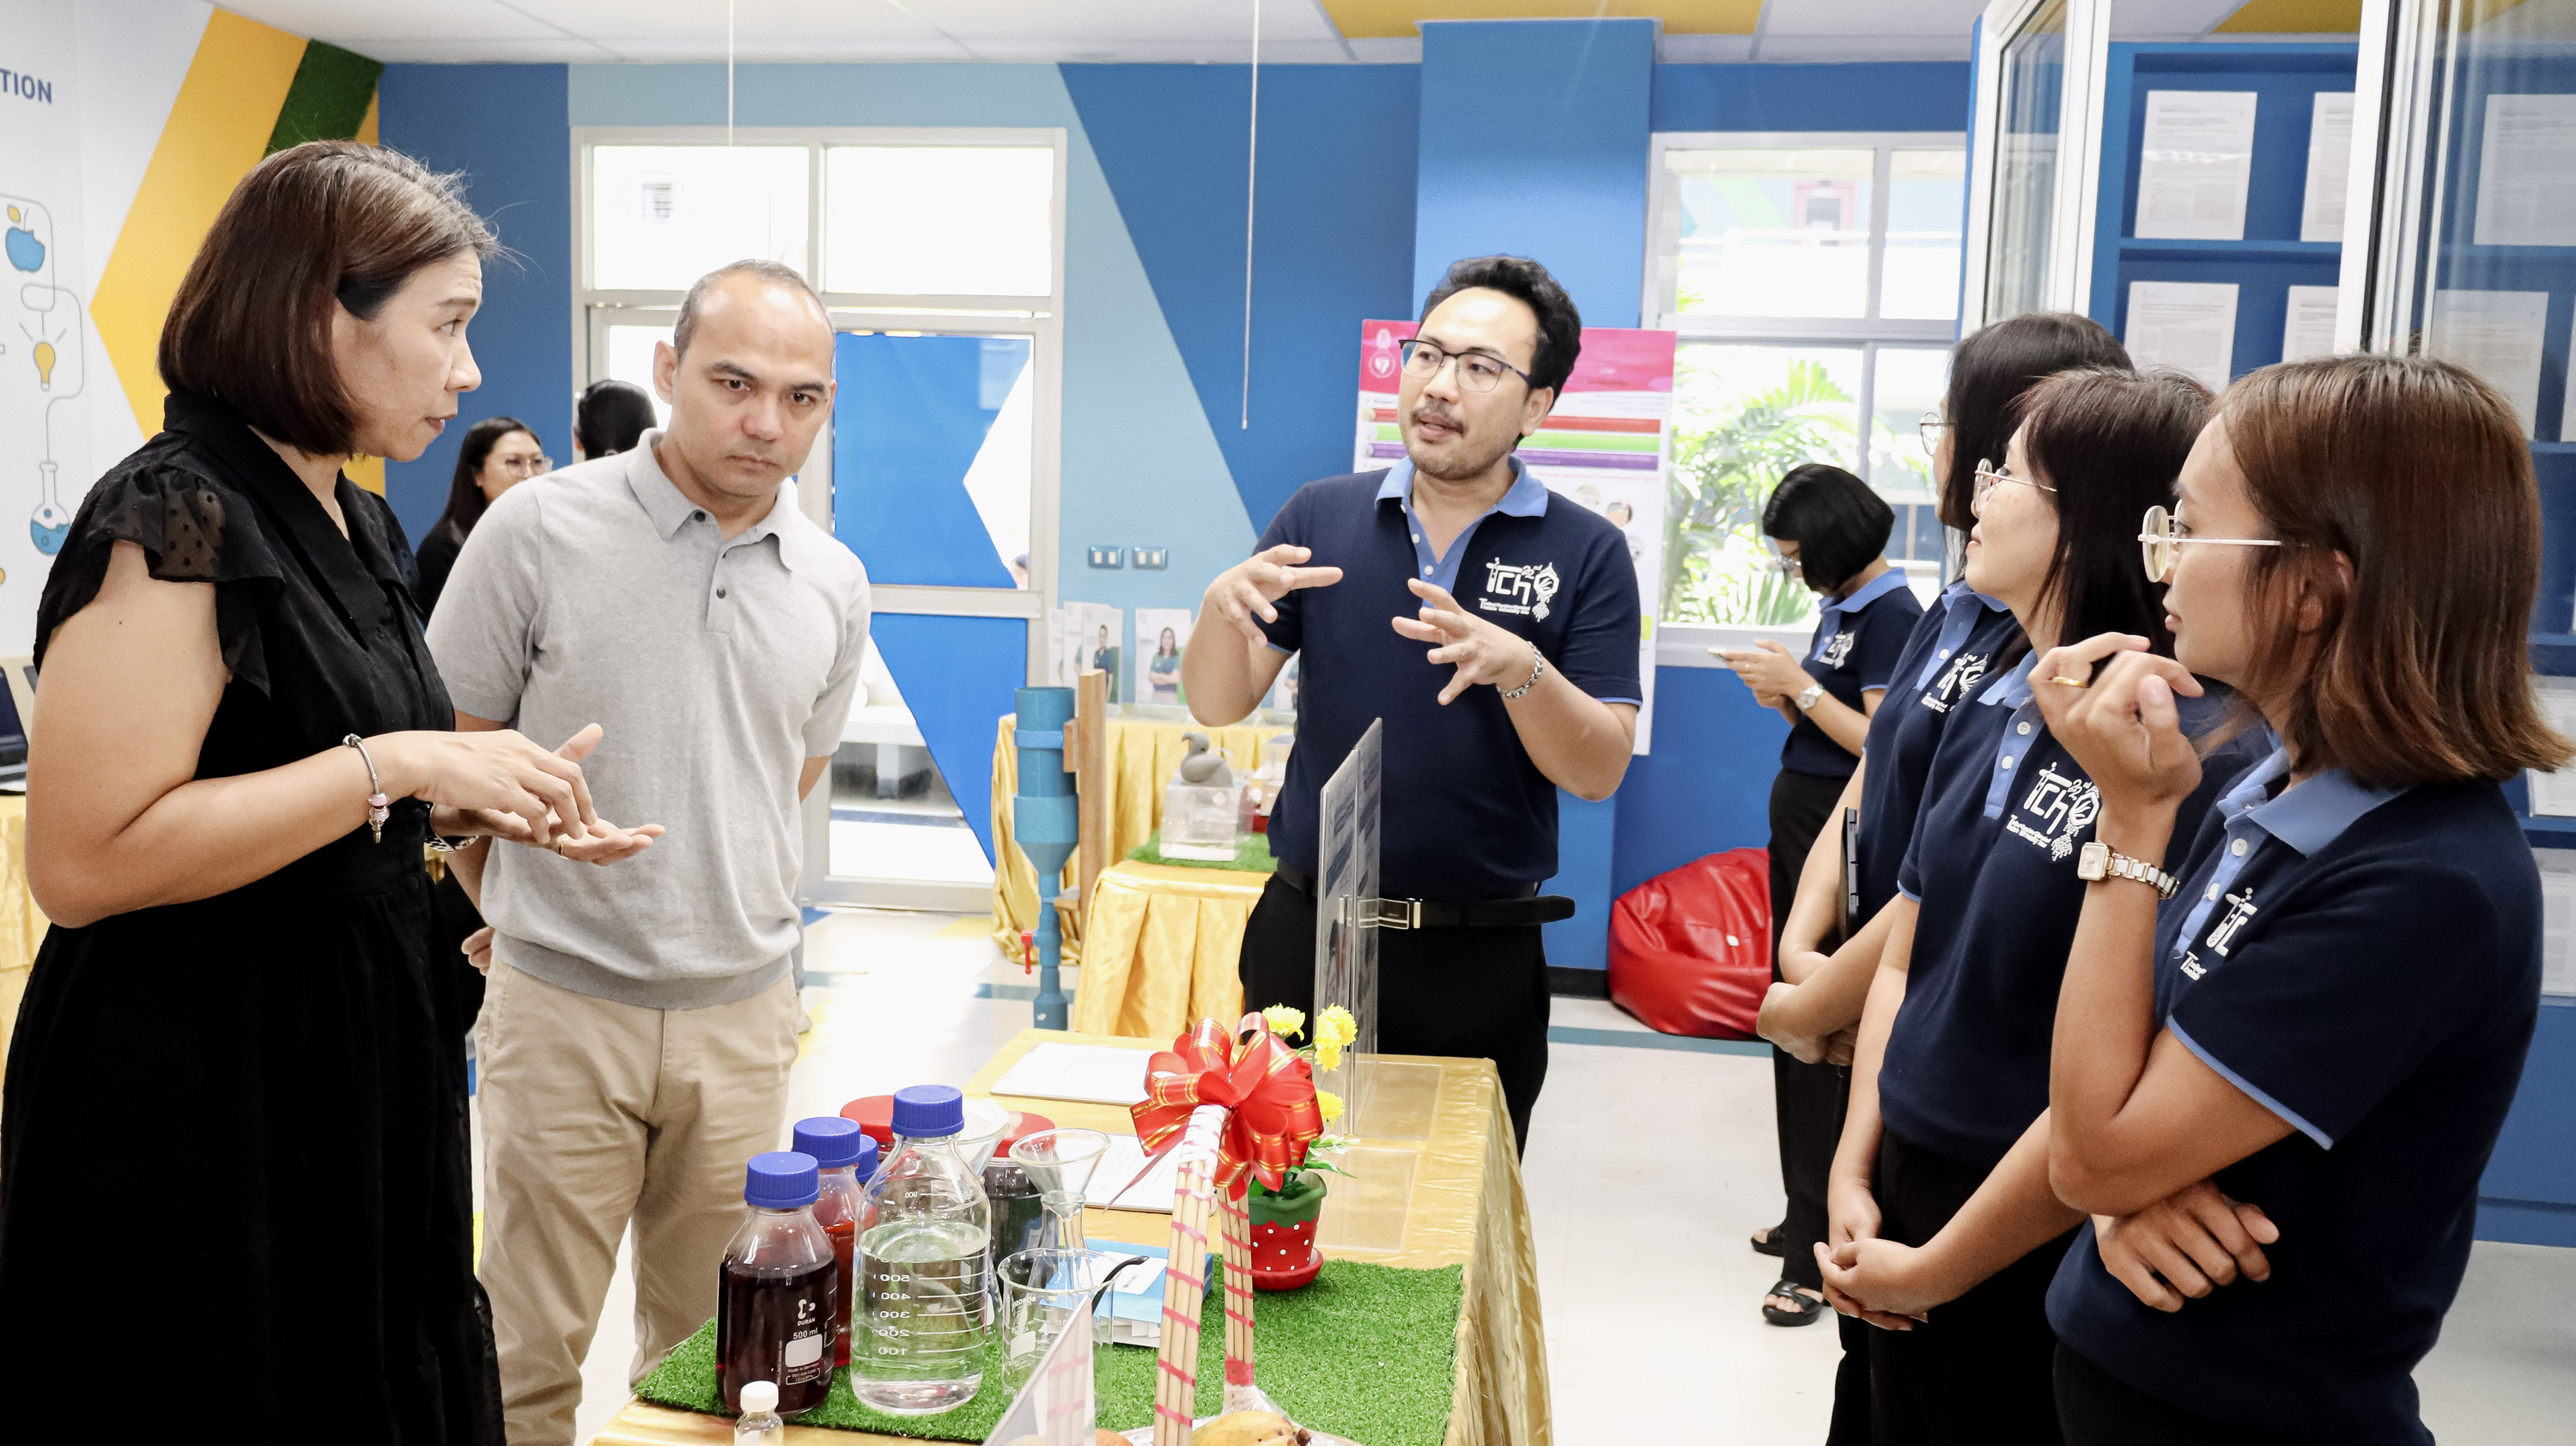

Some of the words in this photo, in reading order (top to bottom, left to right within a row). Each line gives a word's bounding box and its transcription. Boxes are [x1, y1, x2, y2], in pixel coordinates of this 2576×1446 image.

[0, 68, 52, 104] TION
[797, 1317, 816, 1327] DURAN
[793, 1330, 808, 1340] 500
[809, 1327, 818, 1336] ml
